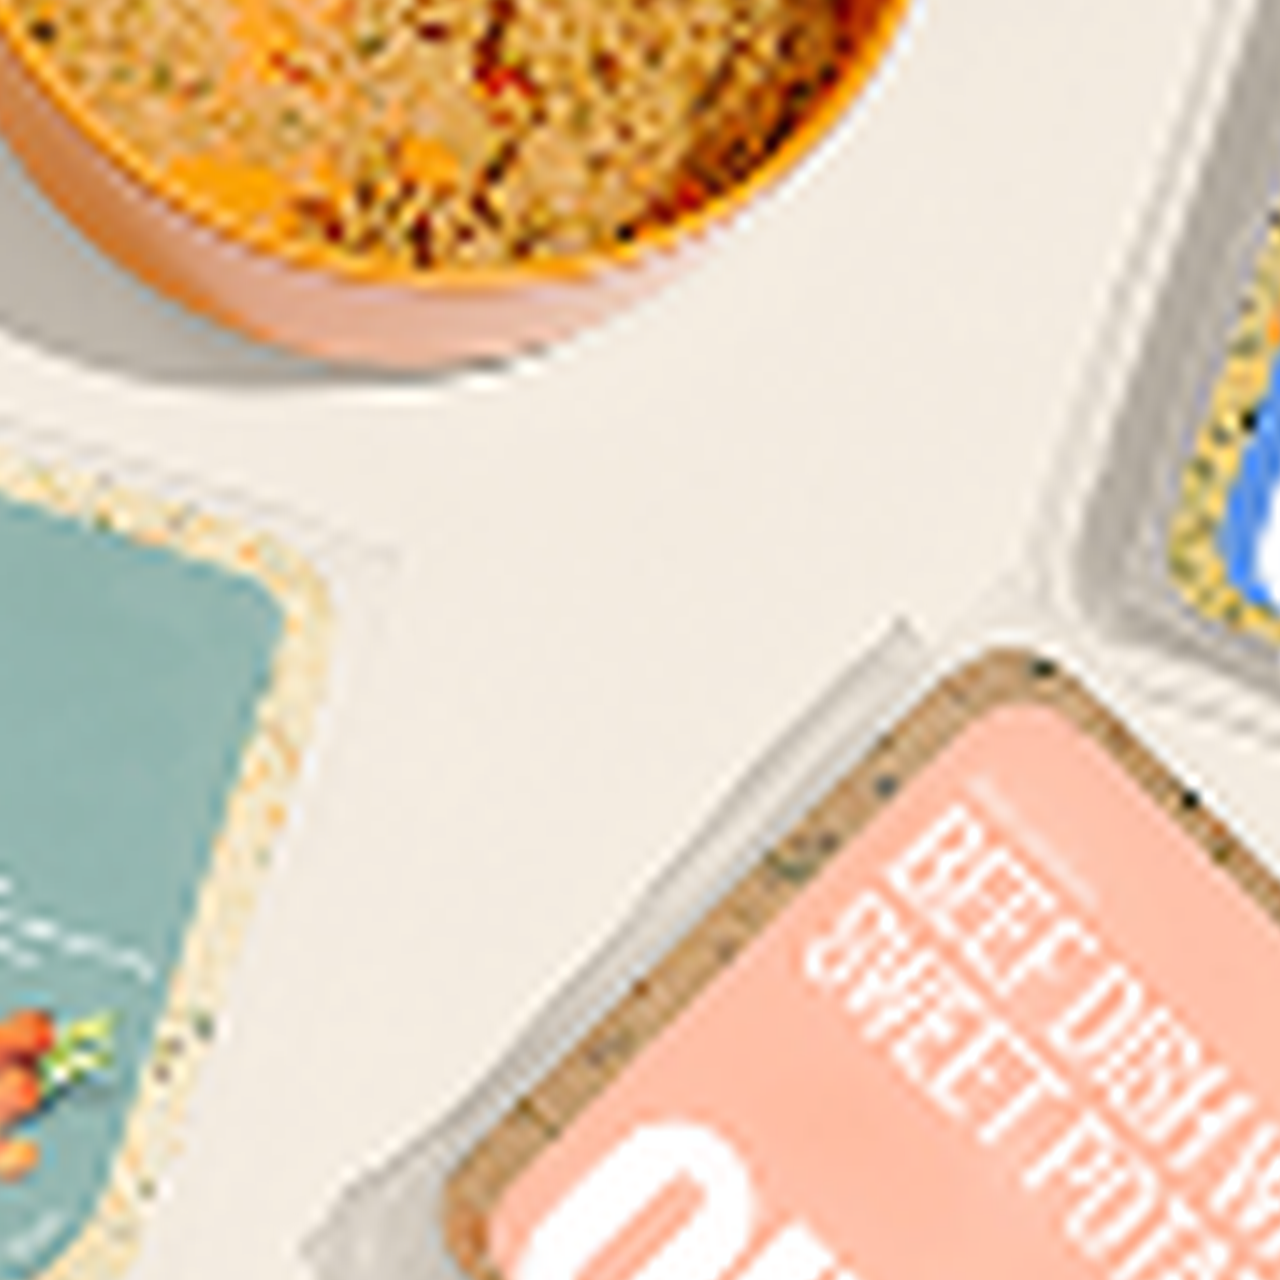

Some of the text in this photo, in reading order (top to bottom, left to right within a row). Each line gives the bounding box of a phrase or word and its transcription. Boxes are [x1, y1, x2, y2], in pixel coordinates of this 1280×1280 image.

[806, 890, 1070, 1148] SWEET
[888, 804, 1099, 995] BEEF
[1048, 964, 1255, 1169] DISH
